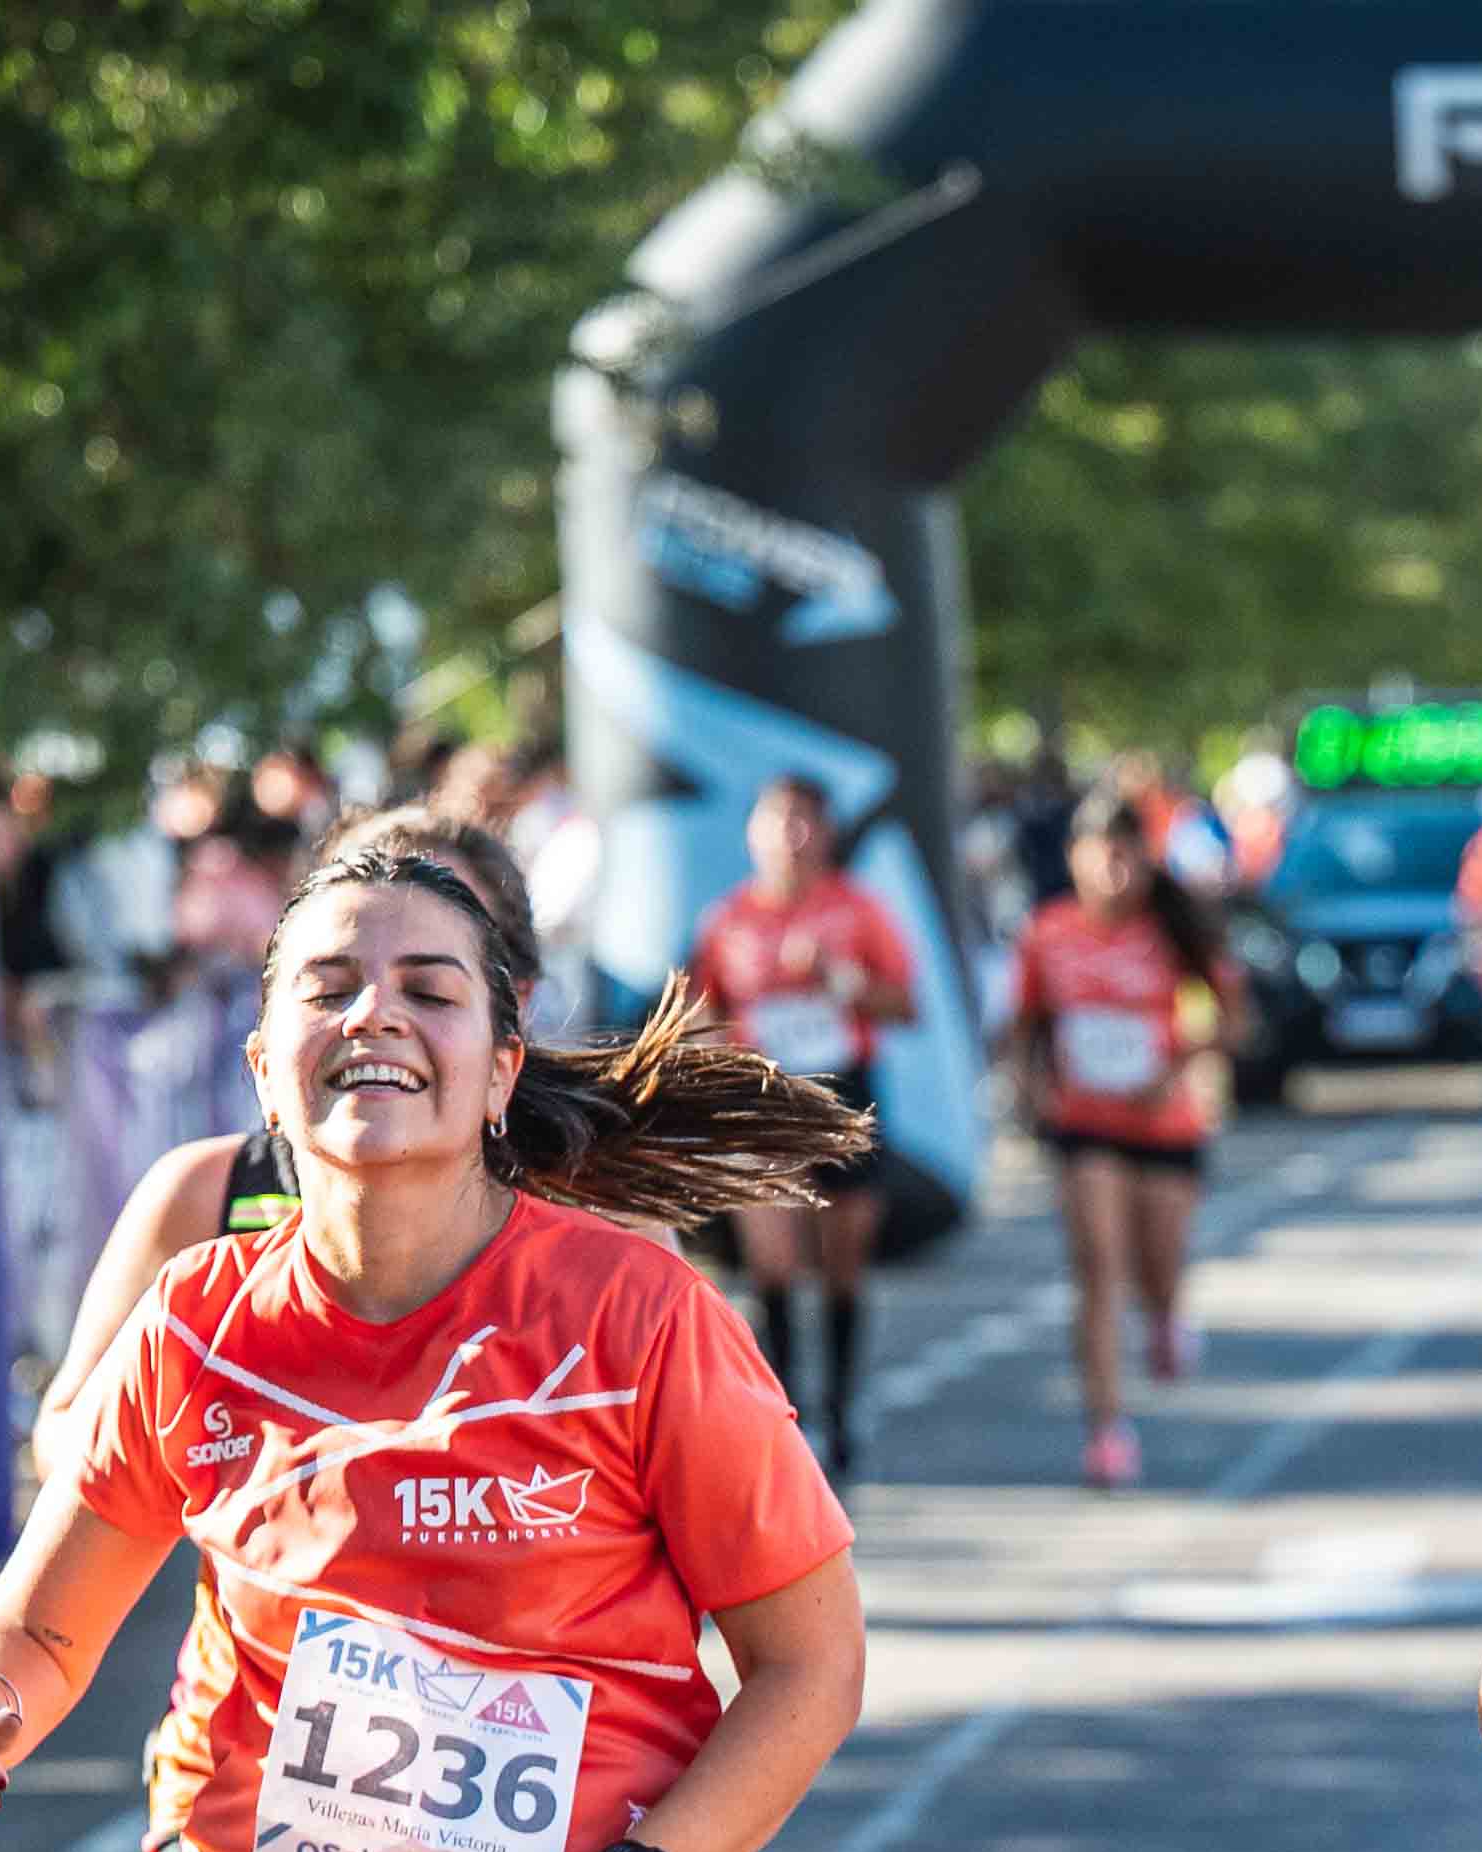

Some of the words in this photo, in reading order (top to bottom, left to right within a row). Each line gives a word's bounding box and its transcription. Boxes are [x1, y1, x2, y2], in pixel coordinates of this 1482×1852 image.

[394, 1476, 499, 1528] 15K
[402, 1527, 498, 1545] PUERTO
[327, 1637, 405, 1691] 15K
[493, 1699, 536, 1726] 15K
[282, 1700, 559, 1834] 1236
[306, 1796, 377, 1831] Villegas
